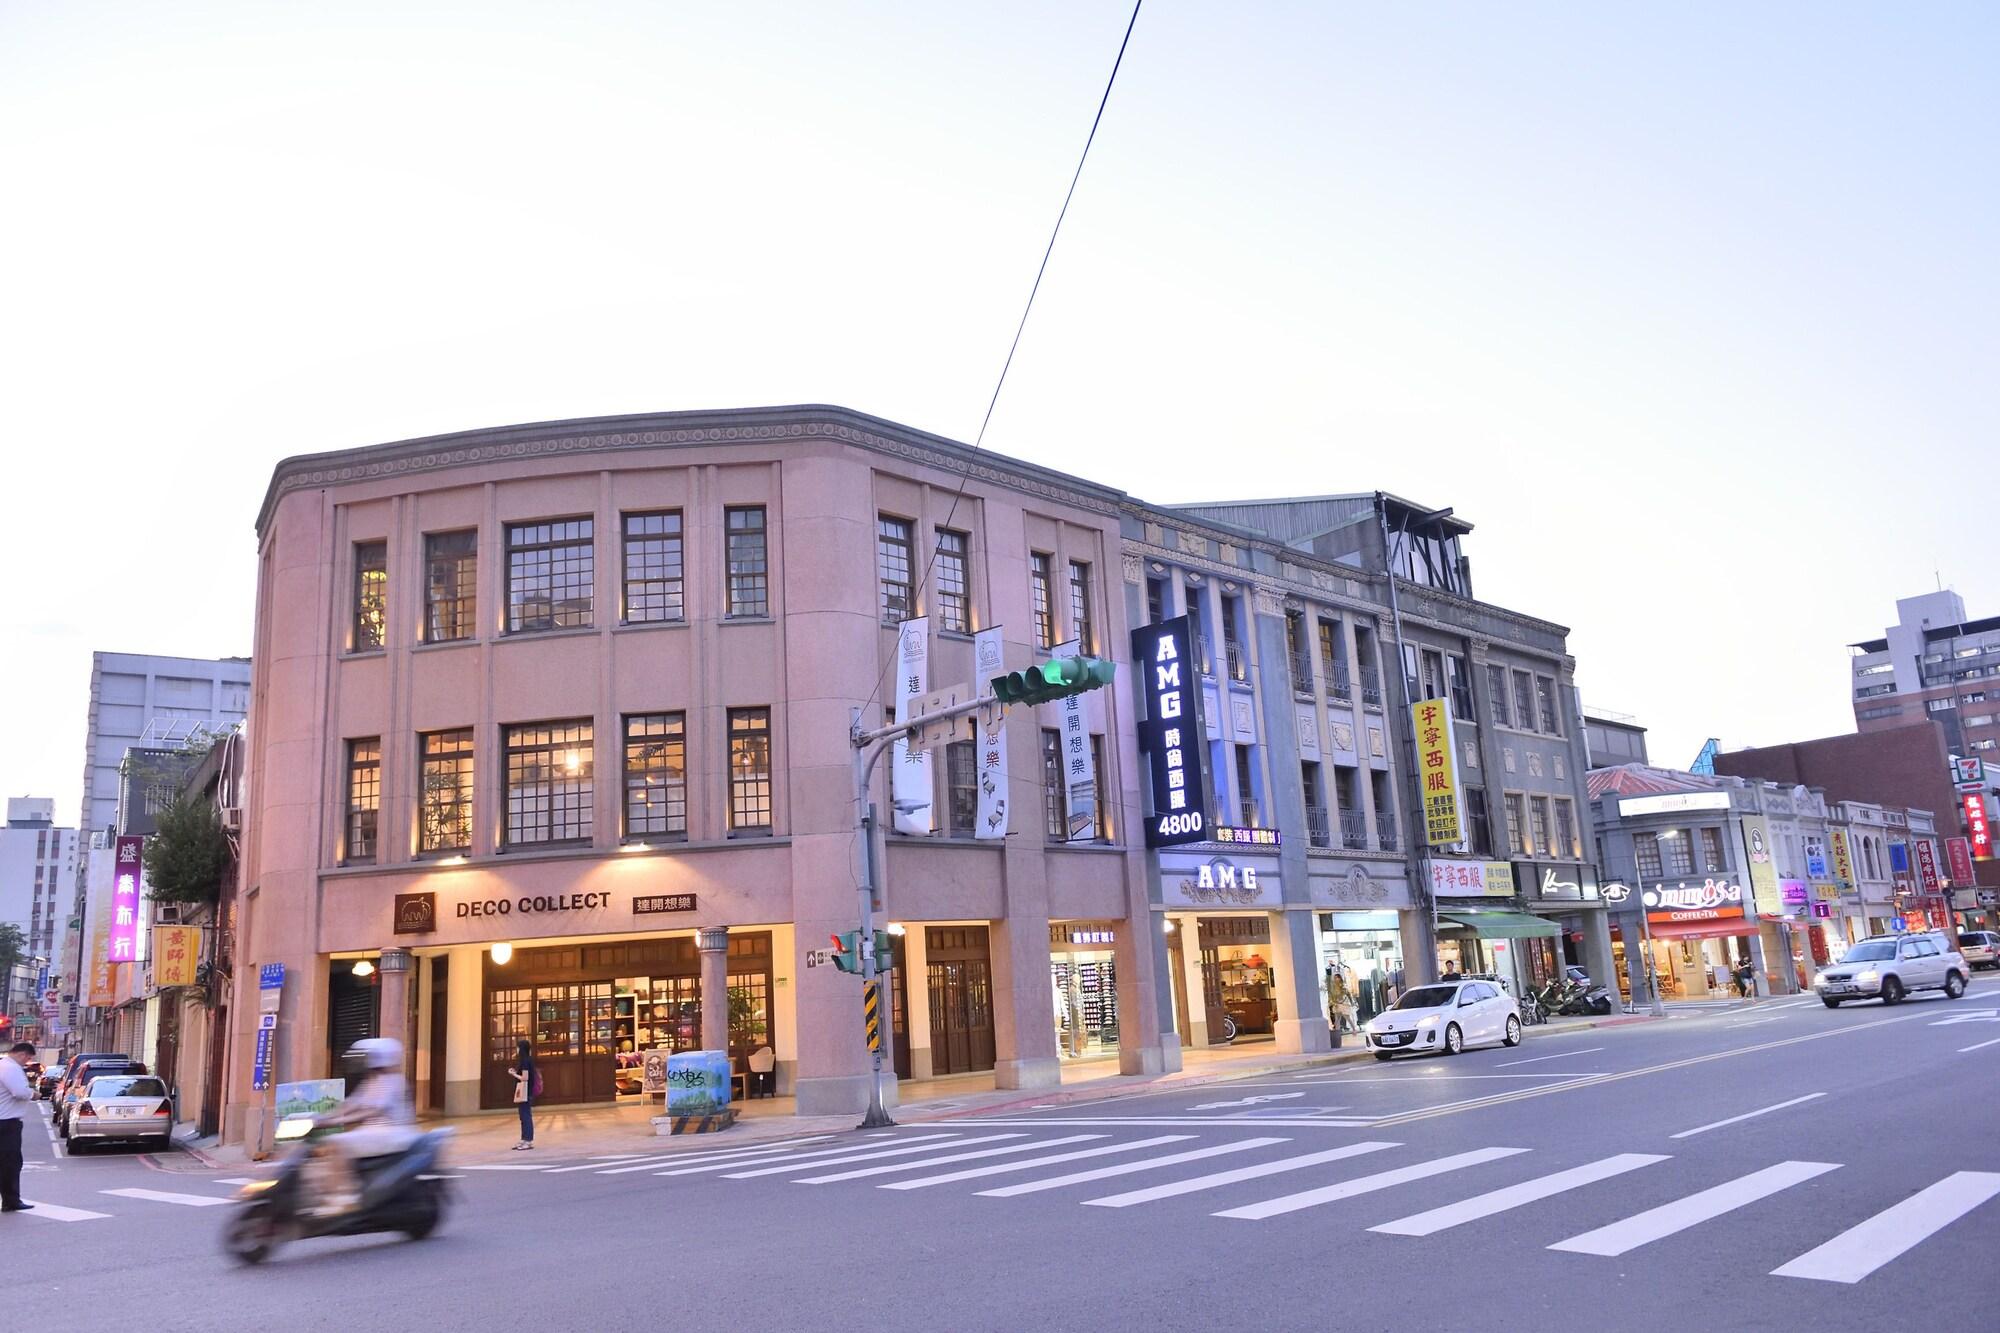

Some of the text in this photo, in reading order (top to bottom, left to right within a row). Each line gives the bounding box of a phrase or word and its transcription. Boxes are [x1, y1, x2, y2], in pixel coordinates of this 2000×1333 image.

[1156, 634, 1181, 720] AMG
[1066, 695, 1085, 775] 達開想樂
[1164, 728, 1186, 810] 時尚西服
[1159, 811, 1202, 836] 4800
[1197, 863, 1257, 889] AMG
[456, 892, 611, 918] DECO COLLECT
[636, 896, 692, 913] 達開想樂
